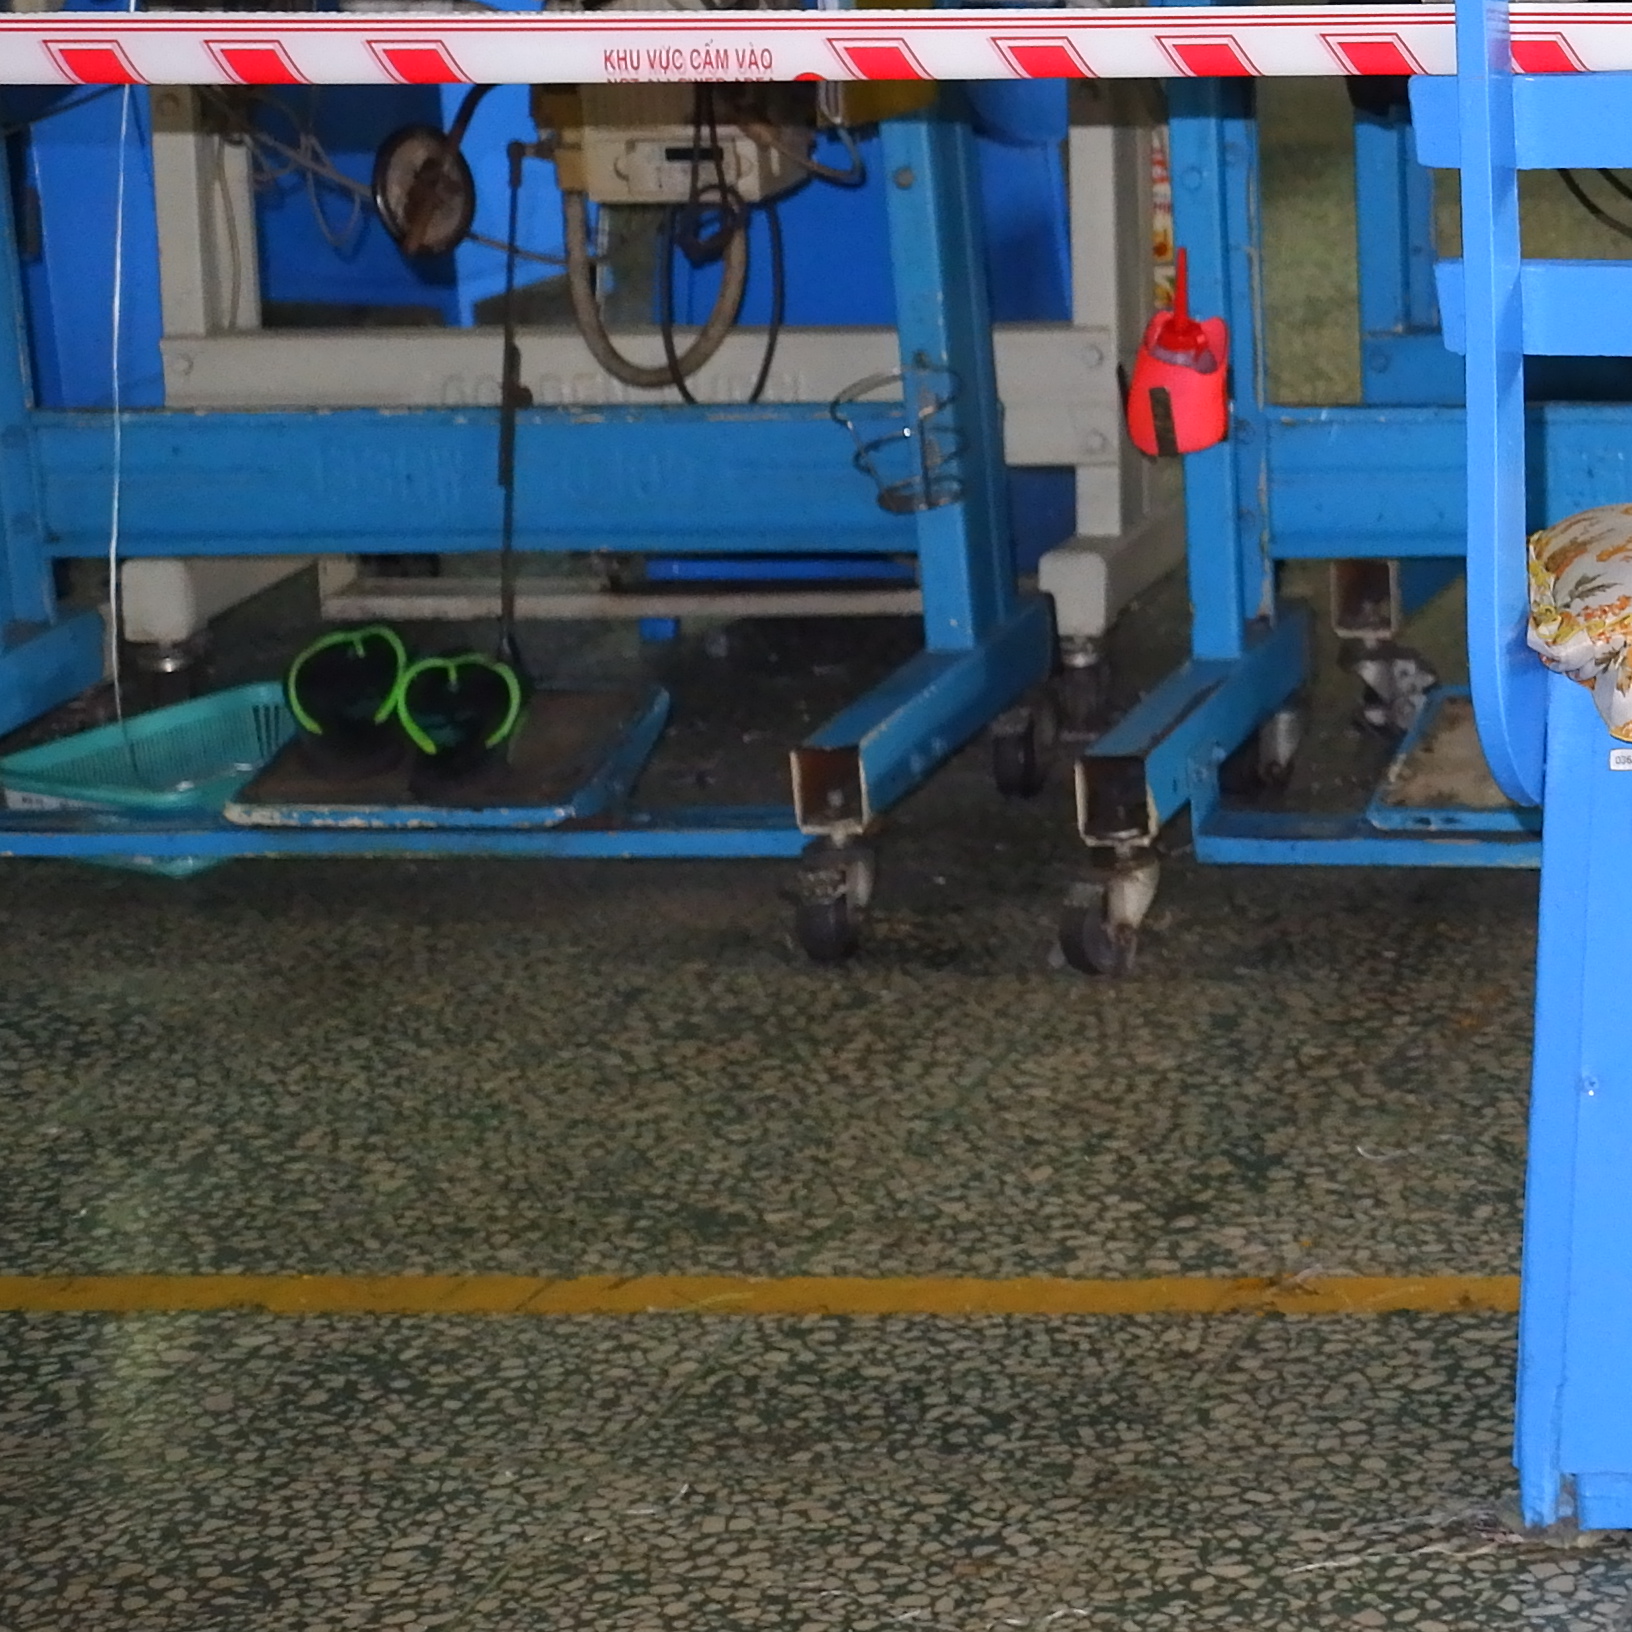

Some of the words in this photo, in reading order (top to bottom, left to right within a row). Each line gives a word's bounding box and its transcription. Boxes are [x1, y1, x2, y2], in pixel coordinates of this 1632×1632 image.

[604, 49, 641, 69] KHU
[690, 39, 729, 69] CẤM
[736, 42, 773, 69] VÀO
